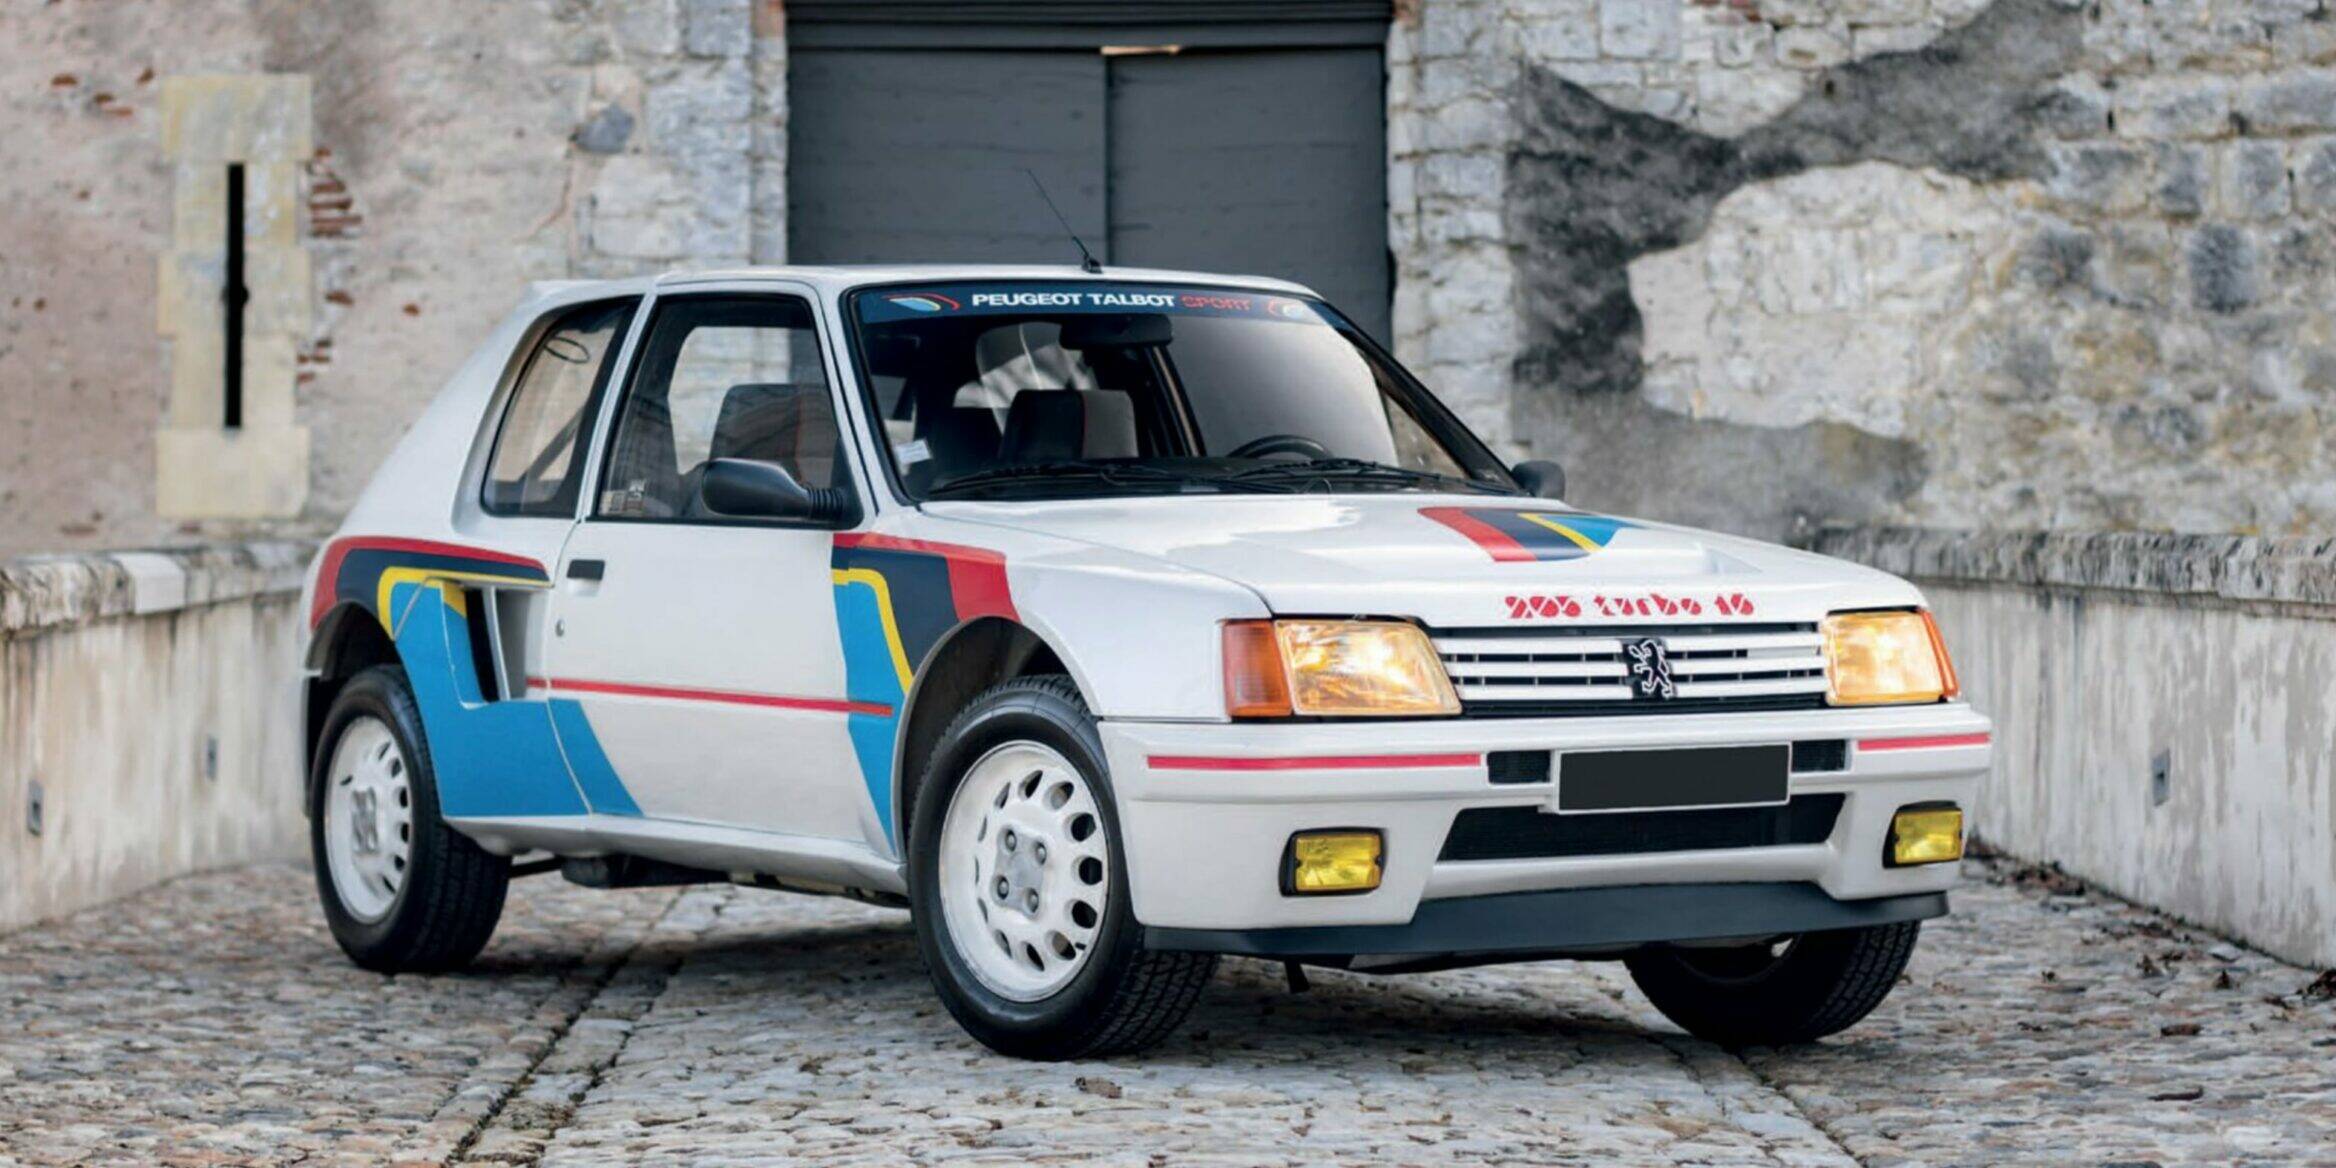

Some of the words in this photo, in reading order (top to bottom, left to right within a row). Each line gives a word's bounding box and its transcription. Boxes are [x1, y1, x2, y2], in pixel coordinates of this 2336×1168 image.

[972, 293, 1082, 306] PEUGEOT
[1087, 294, 1175, 307] TALBOT
[1182, 295, 1251, 311] SPORT
[1504, 595, 1581, 618] 205
[1594, 593, 1703, 616] turbo
[1714, 593, 1755, 616] 16
